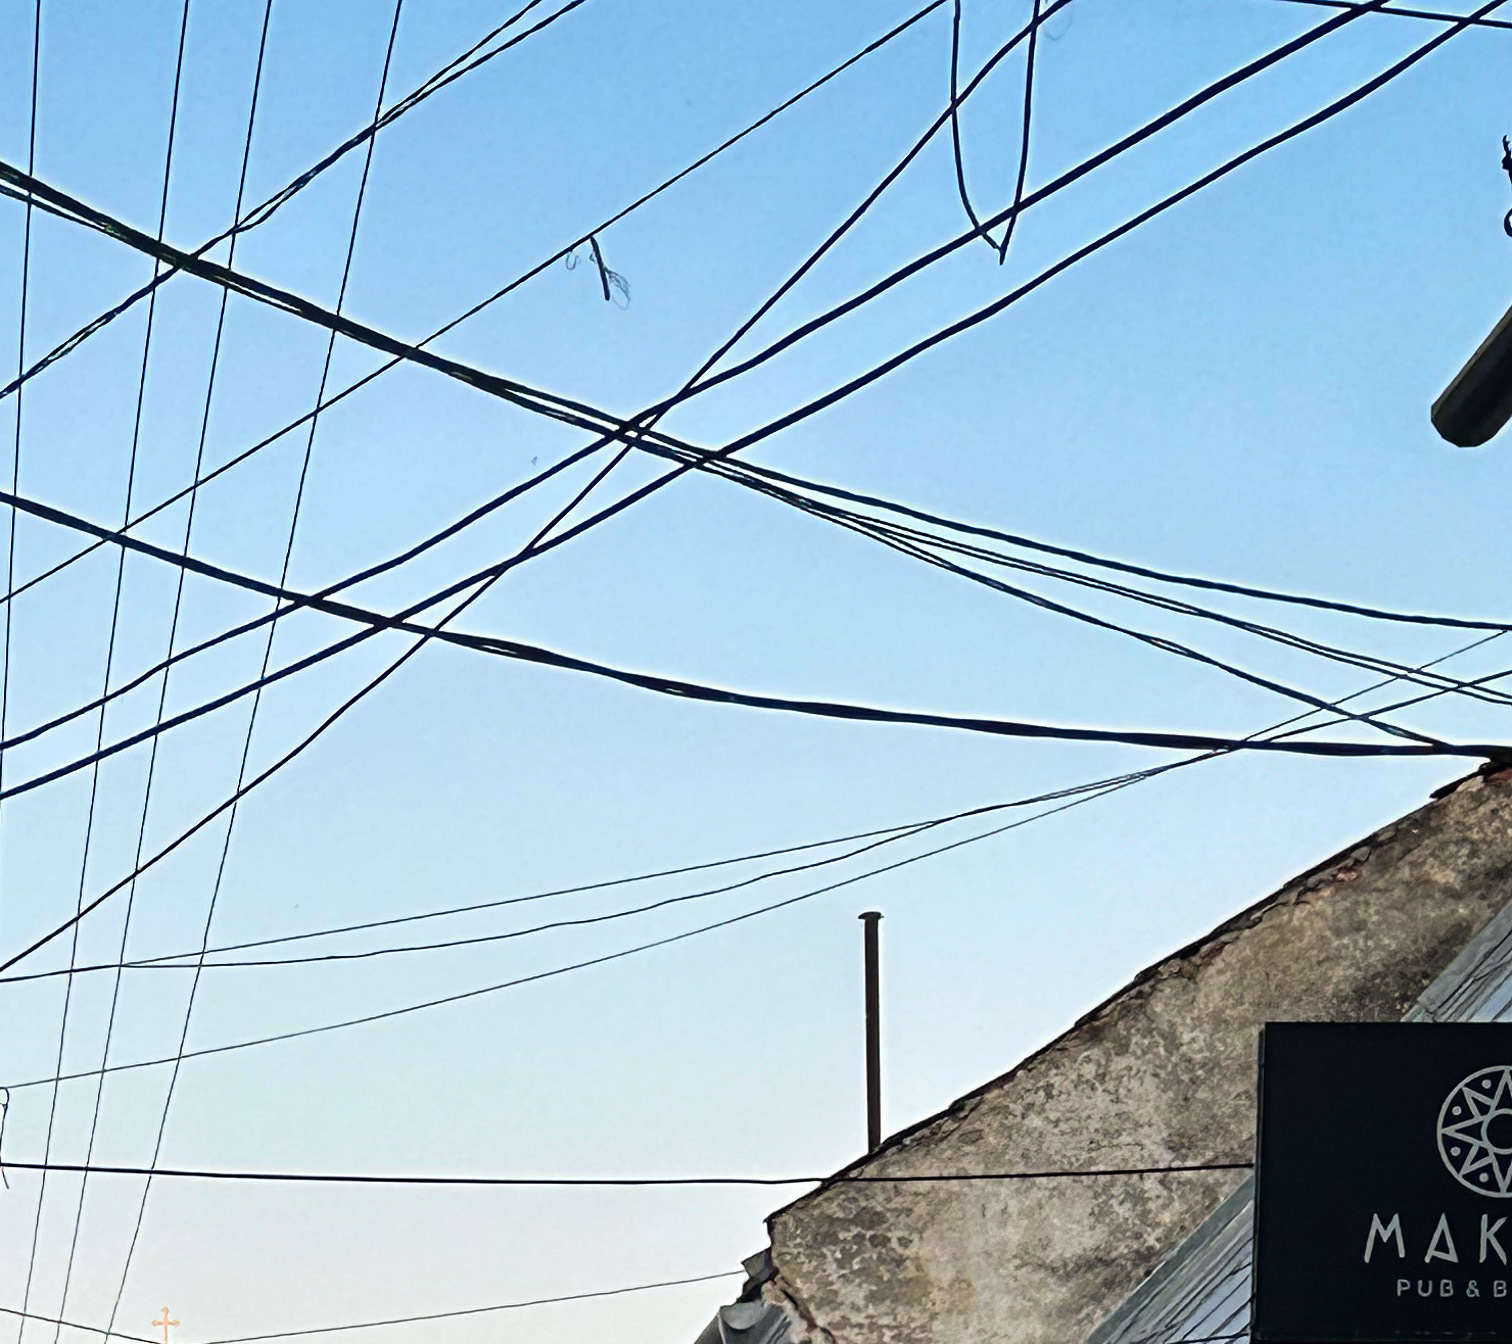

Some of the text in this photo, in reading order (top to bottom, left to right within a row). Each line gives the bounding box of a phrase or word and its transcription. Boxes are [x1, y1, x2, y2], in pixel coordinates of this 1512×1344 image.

[1363, 1212, 1508, 1266] MAK
[1396, 1278, 1454, 1298] PUB
[1465, 1279, 1481, 1298] &
